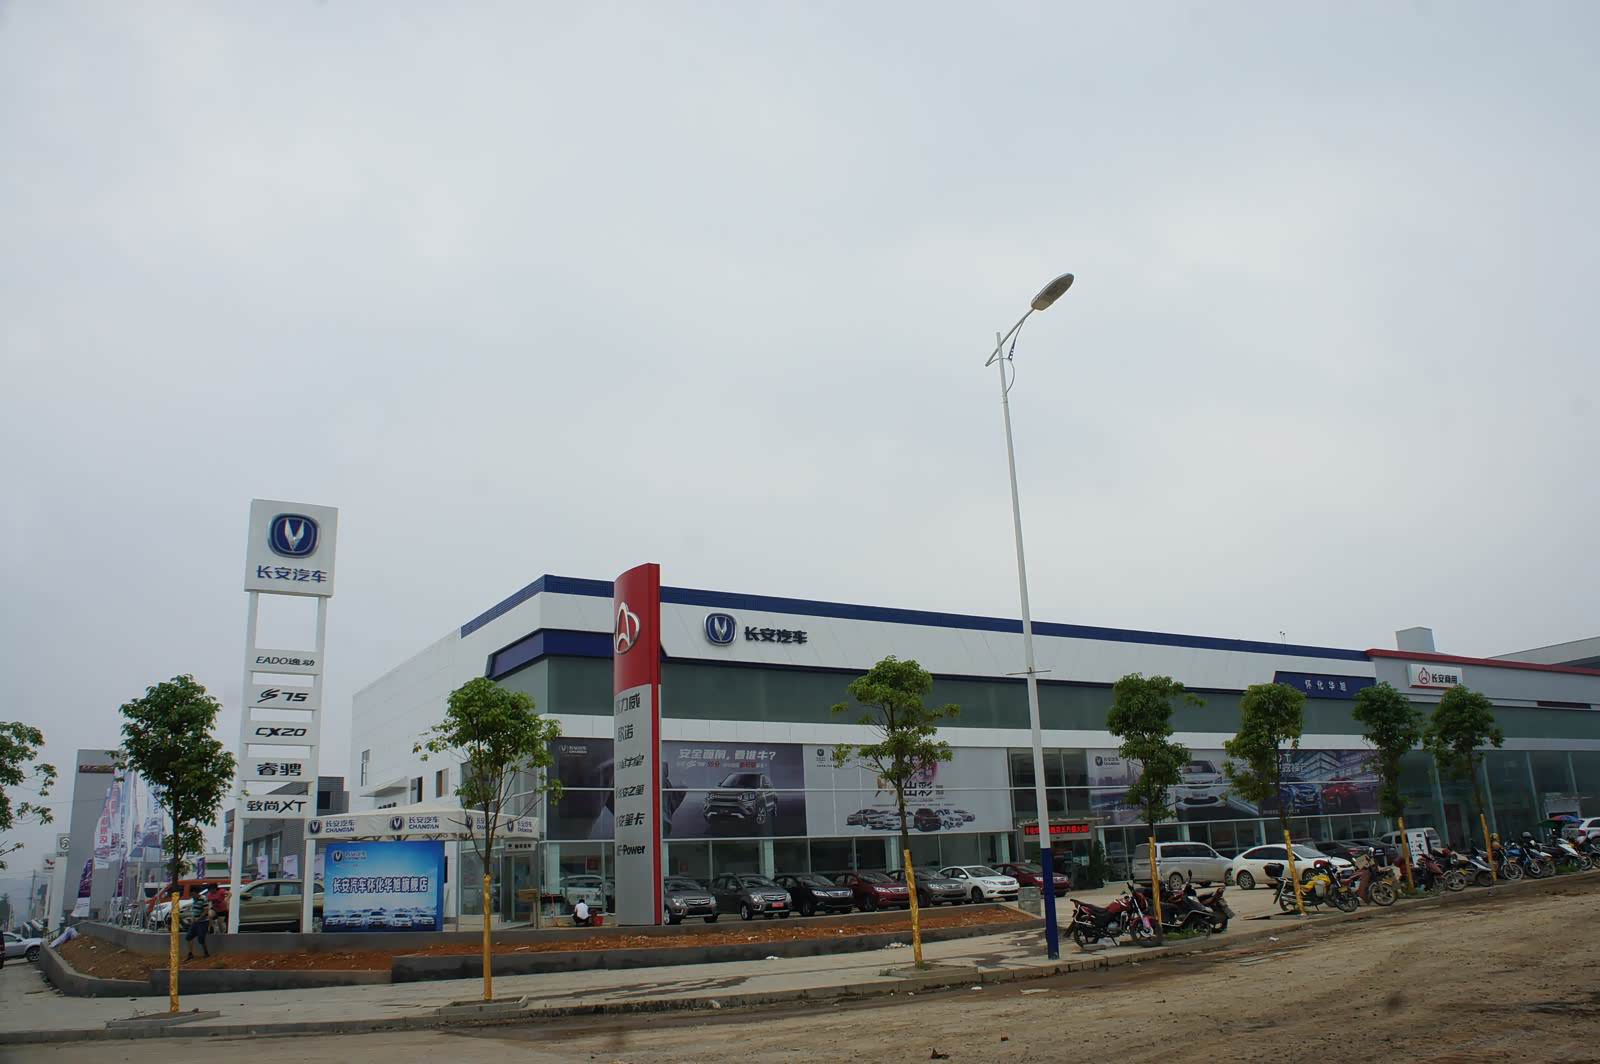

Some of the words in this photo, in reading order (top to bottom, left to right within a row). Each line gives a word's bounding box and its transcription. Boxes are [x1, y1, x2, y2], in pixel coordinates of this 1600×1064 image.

[257, 565, 328, 583] 长安汽车
[744, 626, 808, 644] 长安汽车
[255, 727, 308, 737] CX20
[257, 762, 302, 776] 睿骋
[246, 800, 308, 813] 致尚XT
[325, 820, 354, 828] 长安汽车
[408, 816, 439, 824] 长安汽车
